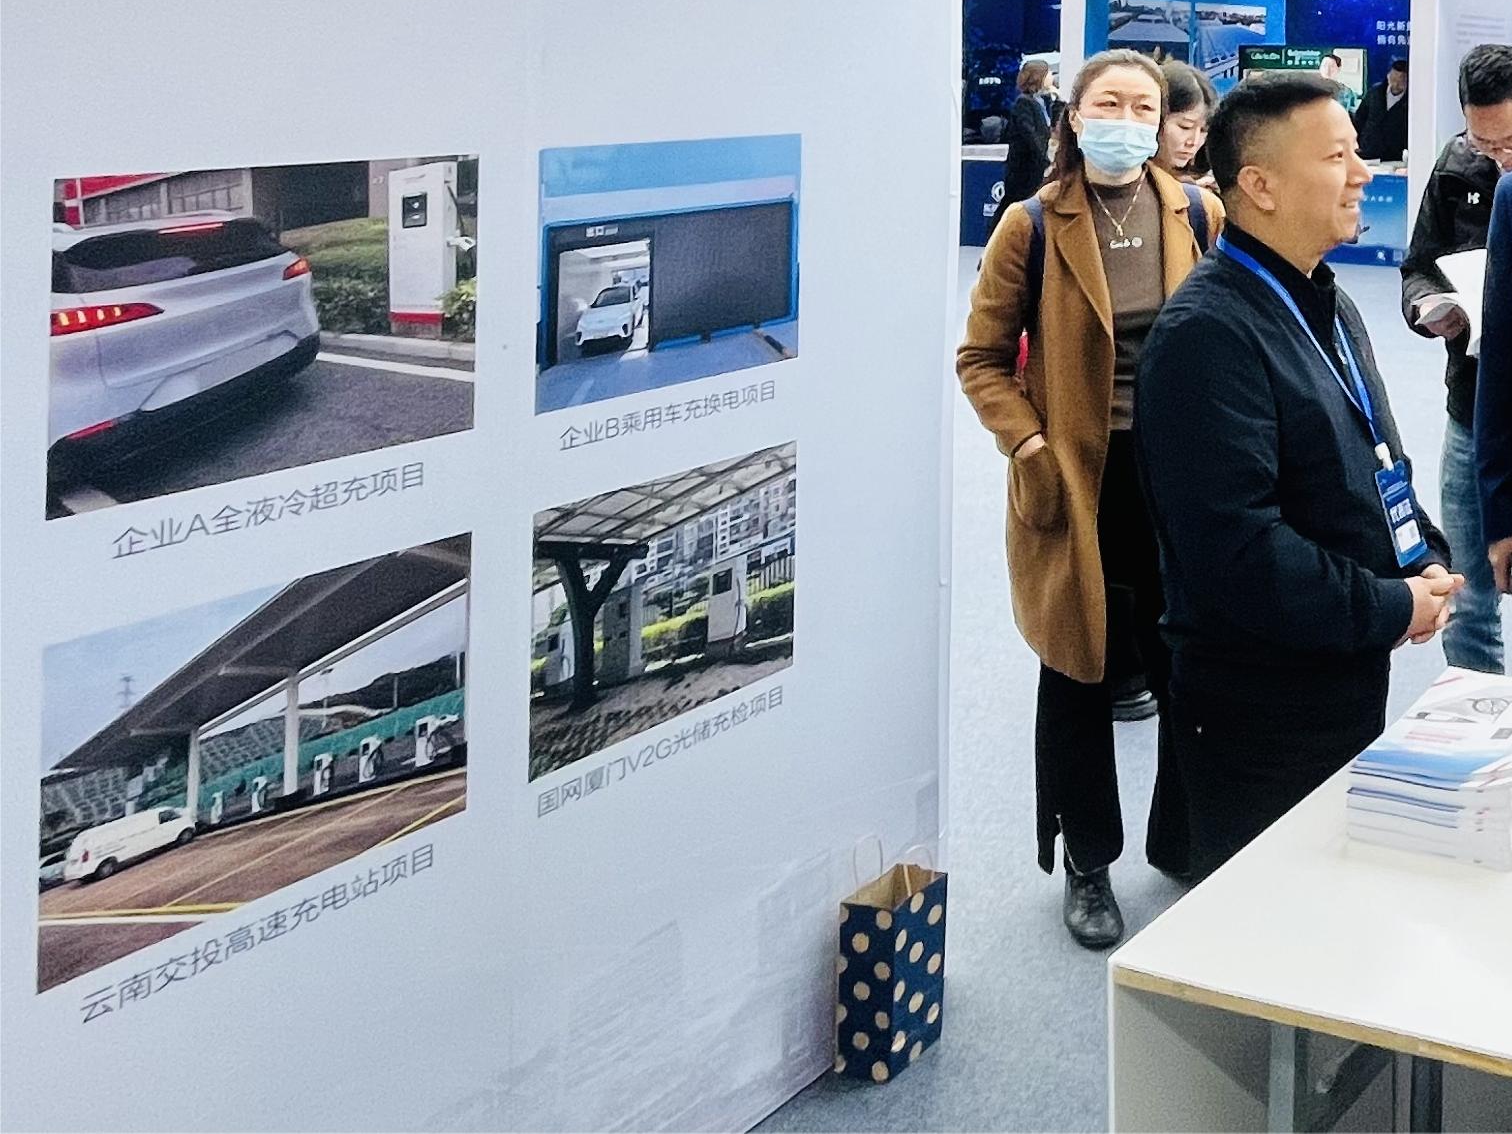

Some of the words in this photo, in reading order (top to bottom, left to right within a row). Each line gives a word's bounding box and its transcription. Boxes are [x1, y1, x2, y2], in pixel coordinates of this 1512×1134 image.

[559, 380, 775, 451] 企业B乘用车充换电项目
[112, 462, 424, 559] 企业A全液冷超充项目
[537, 685, 783, 818] 国网厦门V2G光储充检项目
[80, 843, 434, 1024] 云南交投高速充电站项目
